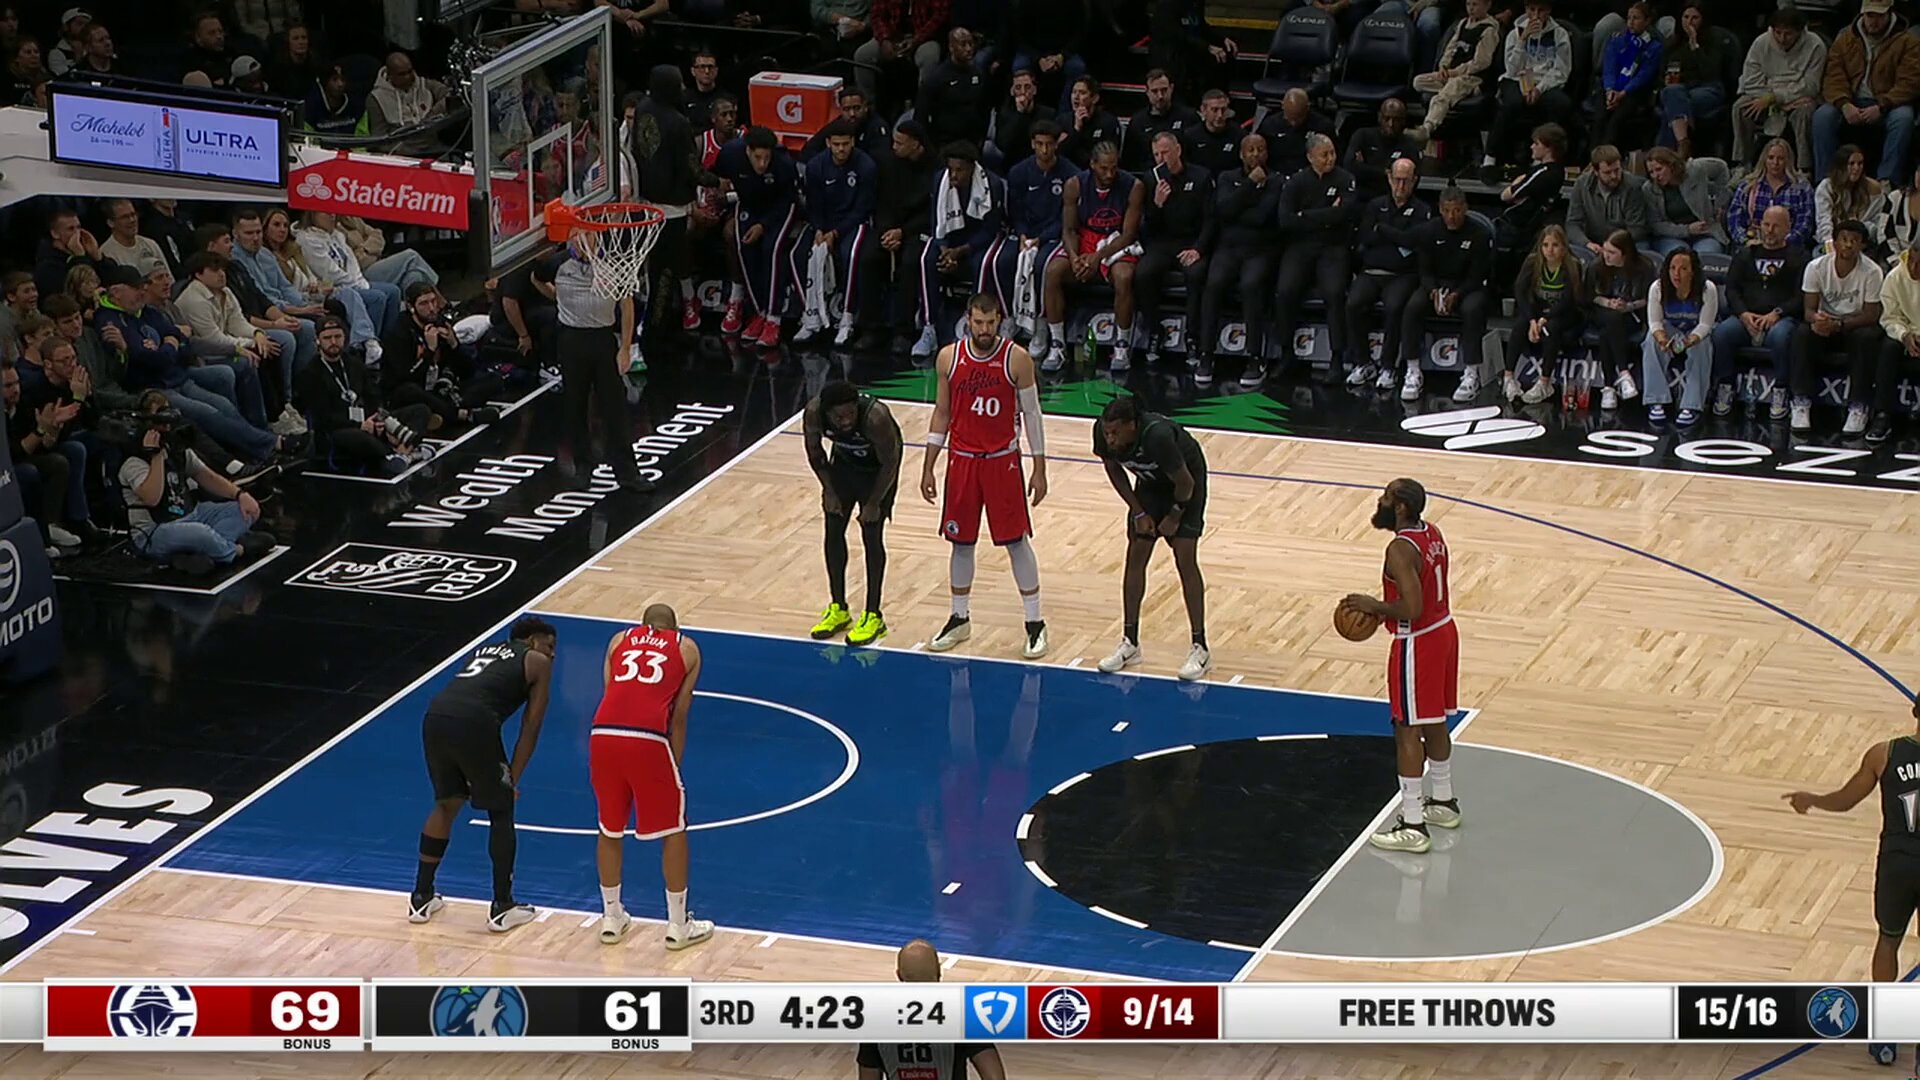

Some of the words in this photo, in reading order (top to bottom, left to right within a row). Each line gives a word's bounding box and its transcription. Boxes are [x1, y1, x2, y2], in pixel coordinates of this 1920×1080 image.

[776, 94, 802, 124] G
[70, 113, 145, 138] Michelob
[186, 128, 258, 151] ULTRA
[1219, 322, 1246, 351] G
[1430, 337, 1458, 367] G
[971, 396, 1001, 417] 40
[387, 453, 556, 529] Wealth
[424, 560, 503, 595] RBC
[1434, 564, 1444, 602] 1
[631, 635, 669, 649] BATUM
[455, 658, 497, 678] 5
[614, 650, 668, 684] 33
[0, 782, 214, 940] LVES
